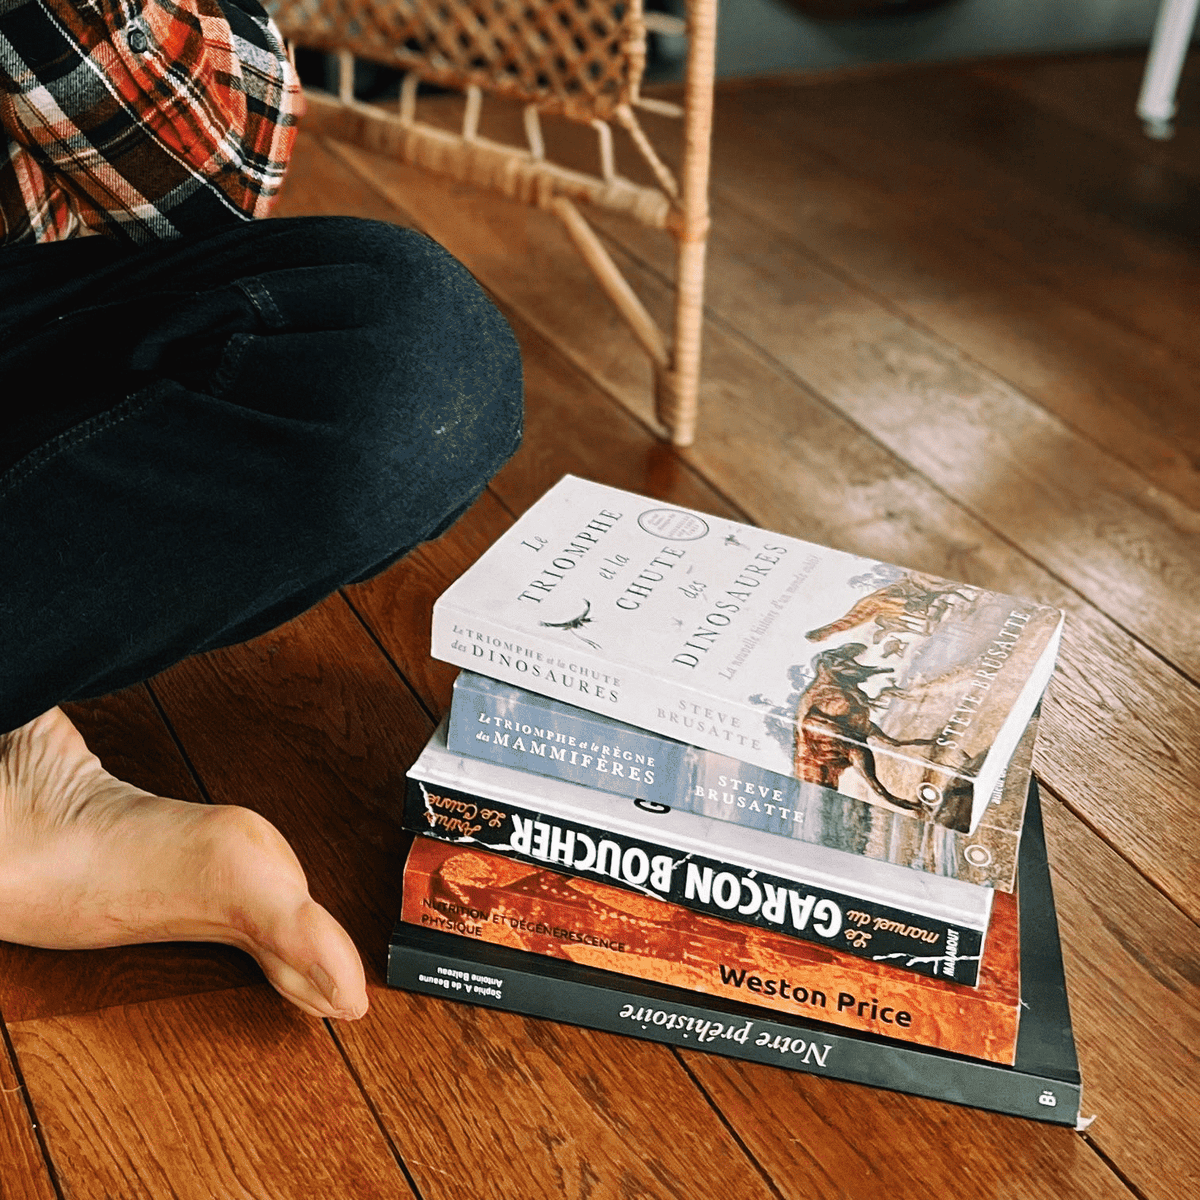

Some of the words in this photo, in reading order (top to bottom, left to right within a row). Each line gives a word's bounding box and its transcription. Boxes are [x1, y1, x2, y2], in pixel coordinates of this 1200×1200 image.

[517, 508, 624, 605] TRIOMPHE
[521, 535, 549, 554] Le
[598, 562, 615, 581] et
[614, 552, 631, 569] la
[616, 545, 686, 612] CHUTE
[673, 542, 788, 669] DINOSAURES
[679, 579, 707, 601] des
[451, 640, 467, 653] des
[472, 644, 619, 703] DINOSAURES
[465, 629, 543, 662] TRIOMPHE
[569, 663, 621, 687] CHUTE
[936, 693, 983, 750] STEVE
[971, 610, 1031, 691] BRUSATTE
[657, 707, 761, 750] BRUSATTE
[678, 700, 742, 728] STEVE
[476, 731, 490, 742] des
[493, 731, 655, 785] MAMMIFÈRES
[478, 713, 491, 724] Le
[493, 717, 577, 746] TRIOMPHE
[601, 746, 655, 767] RÈGNE
[428, 793, 477, 820] Caisne
[694, 785, 805, 824] BRUSATTE
[718, 775, 783, 802] STEVE
[480, 808, 506, 828] Le
[510, 814, 673, 893] BOUCHER
[422, 898, 489, 921] NUTRITION
[492, 911, 508, 926] ET
[685, 869, 842, 938] GARÇON
[846, 909, 871, 927] du
[421, 913, 483, 936] PHYSIQUE
[844, 928, 872, 949] Le
[873, 917, 940, 945] manuel
[471, 974, 503, 988] Antoine
[473, 985, 502, 999] Sophie
[719, 964, 827, 1008] Weston
[837, 992, 912, 1028] Price
[618, 1003, 754, 1044] préhistoire
[755, 1030, 833, 1068] Notre
